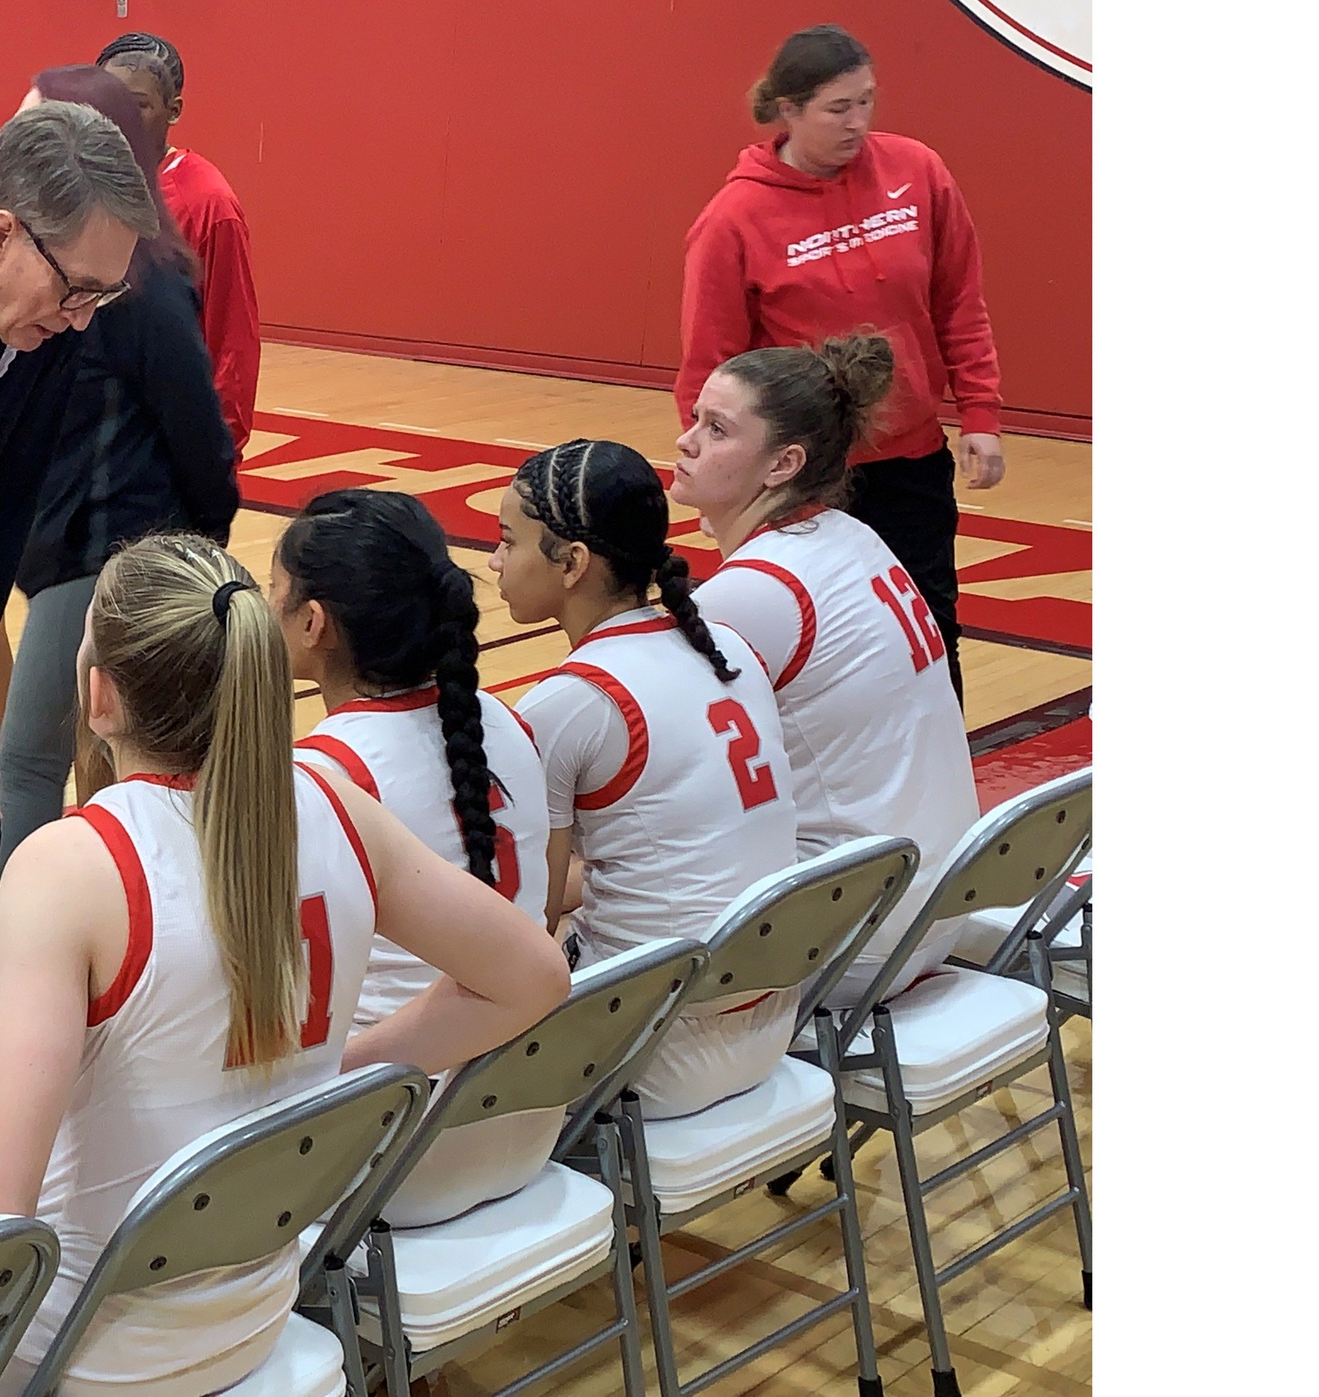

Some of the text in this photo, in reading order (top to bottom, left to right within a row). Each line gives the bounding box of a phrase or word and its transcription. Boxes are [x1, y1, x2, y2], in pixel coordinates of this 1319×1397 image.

[787, 242, 849, 267] SPORS
[869, 564, 946, 677] 12
[706, 696, 778, 813] 2
